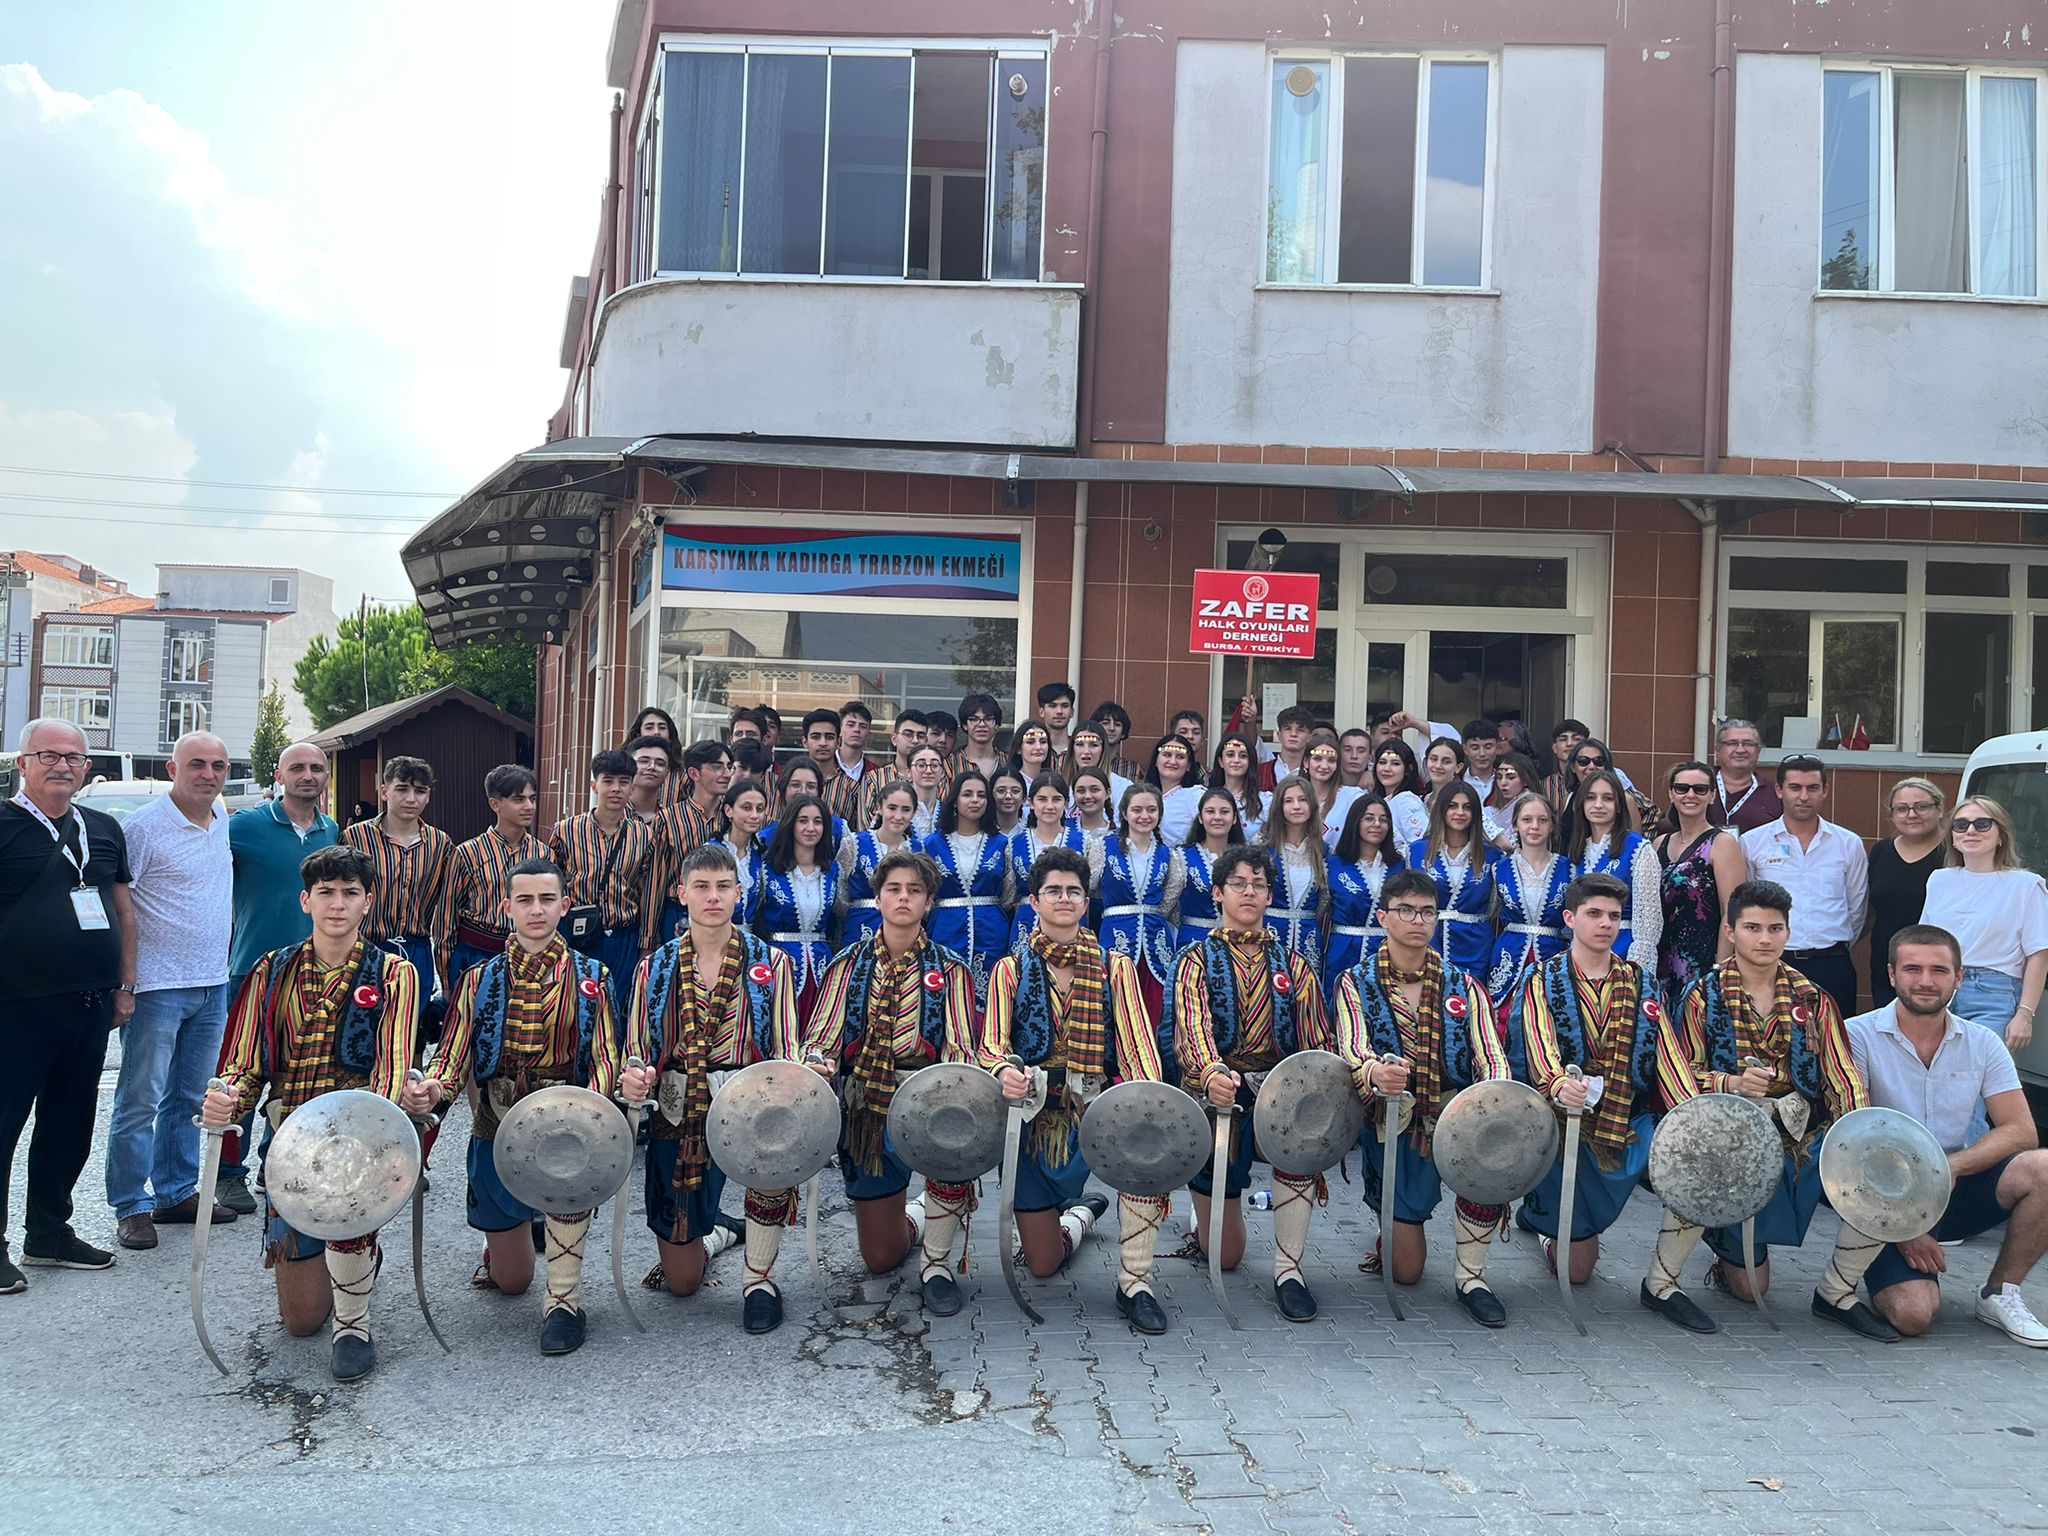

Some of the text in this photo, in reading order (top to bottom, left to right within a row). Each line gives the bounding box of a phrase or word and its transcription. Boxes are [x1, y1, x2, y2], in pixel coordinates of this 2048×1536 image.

[674, 548, 1005, 578] KARŞIYAKA KADIRGA TRABZON EKMEĞİ
[1199, 599, 1310, 621] ZAFER
[1199, 619, 1310, 633] HALK OYUNLARI
[1222, 631, 1284, 643] DERNEĞİ
[1203, 642, 1242, 651] BURSA
[1250, 644, 1301, 654] TÜRKİYE
